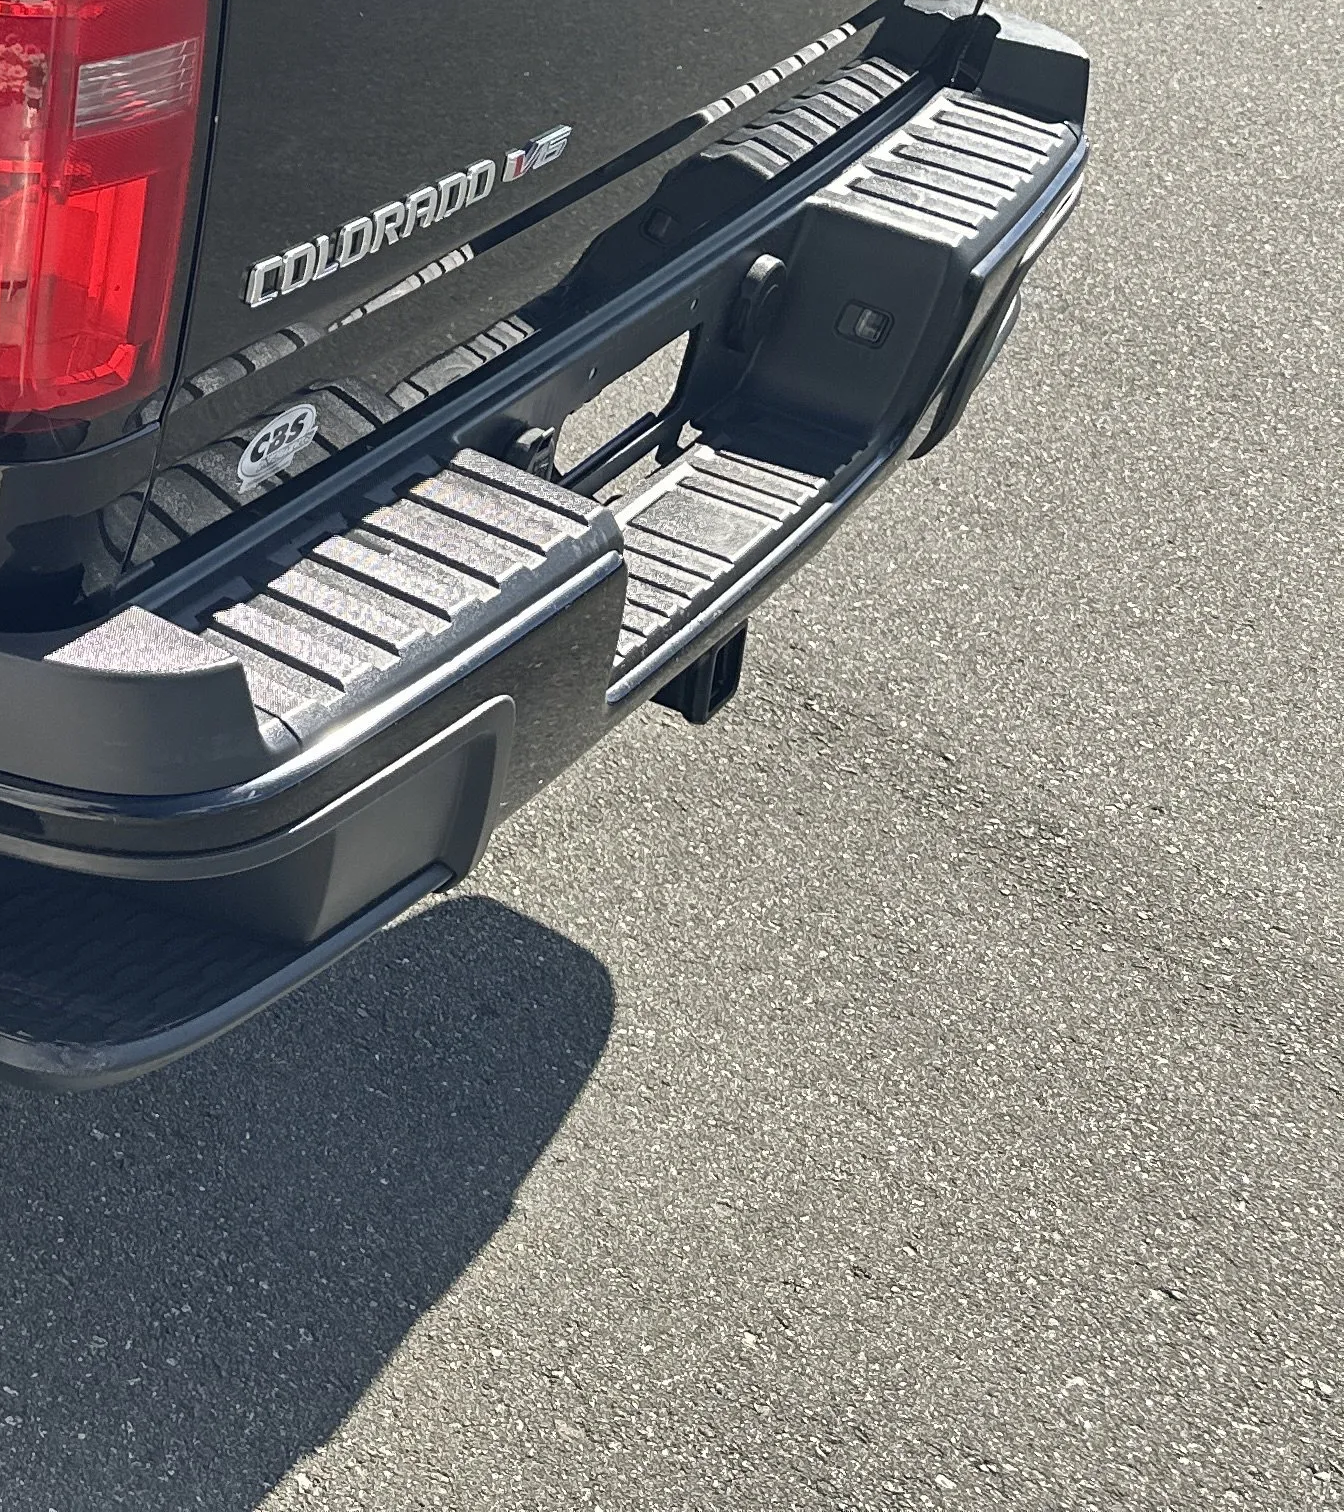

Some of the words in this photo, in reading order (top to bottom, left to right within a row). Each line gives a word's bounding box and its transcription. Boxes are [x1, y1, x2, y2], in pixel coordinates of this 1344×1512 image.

[241, 159, 495, 307] COLORADO
[502, 124, 573, 182] V6
[249, 411, 309, 463] CBS
